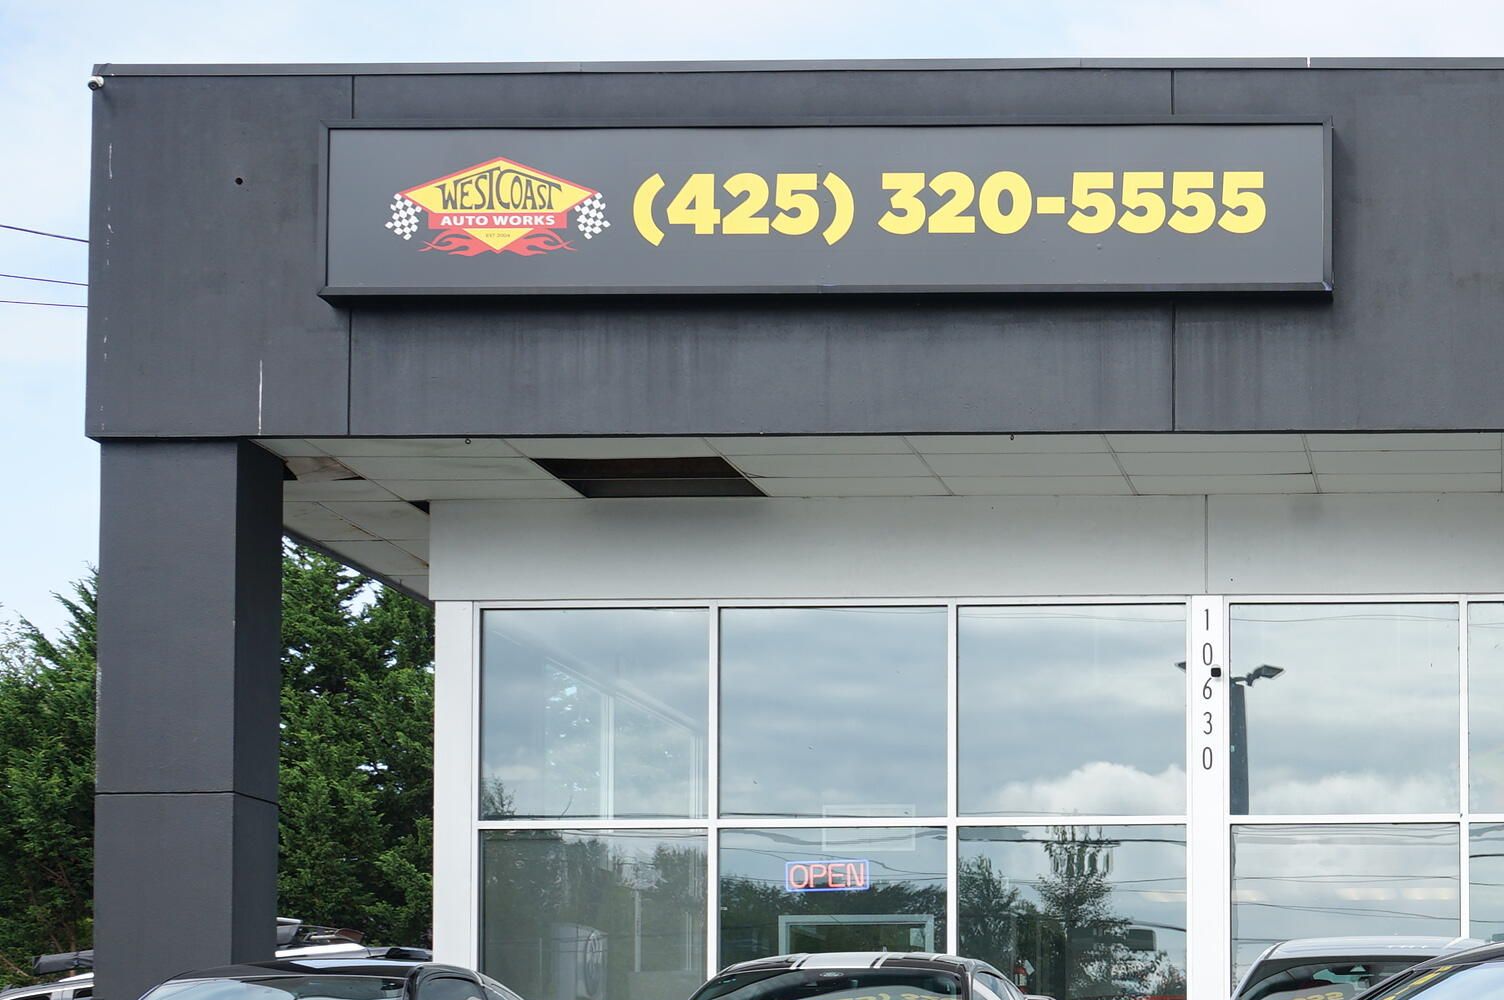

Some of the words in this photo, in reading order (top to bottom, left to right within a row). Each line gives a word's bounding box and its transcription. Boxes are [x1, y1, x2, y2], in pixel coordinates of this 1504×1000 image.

[440, 215, 489, 226] AUTO
[492, 215, 556, 226] WORKS
[633, 172, 855, 247] (425)
[877, 170, 1267, 235] 320-5555
[1202, 609, 1213, 770] 10630
[789, 863, 865, 889] OPEN
